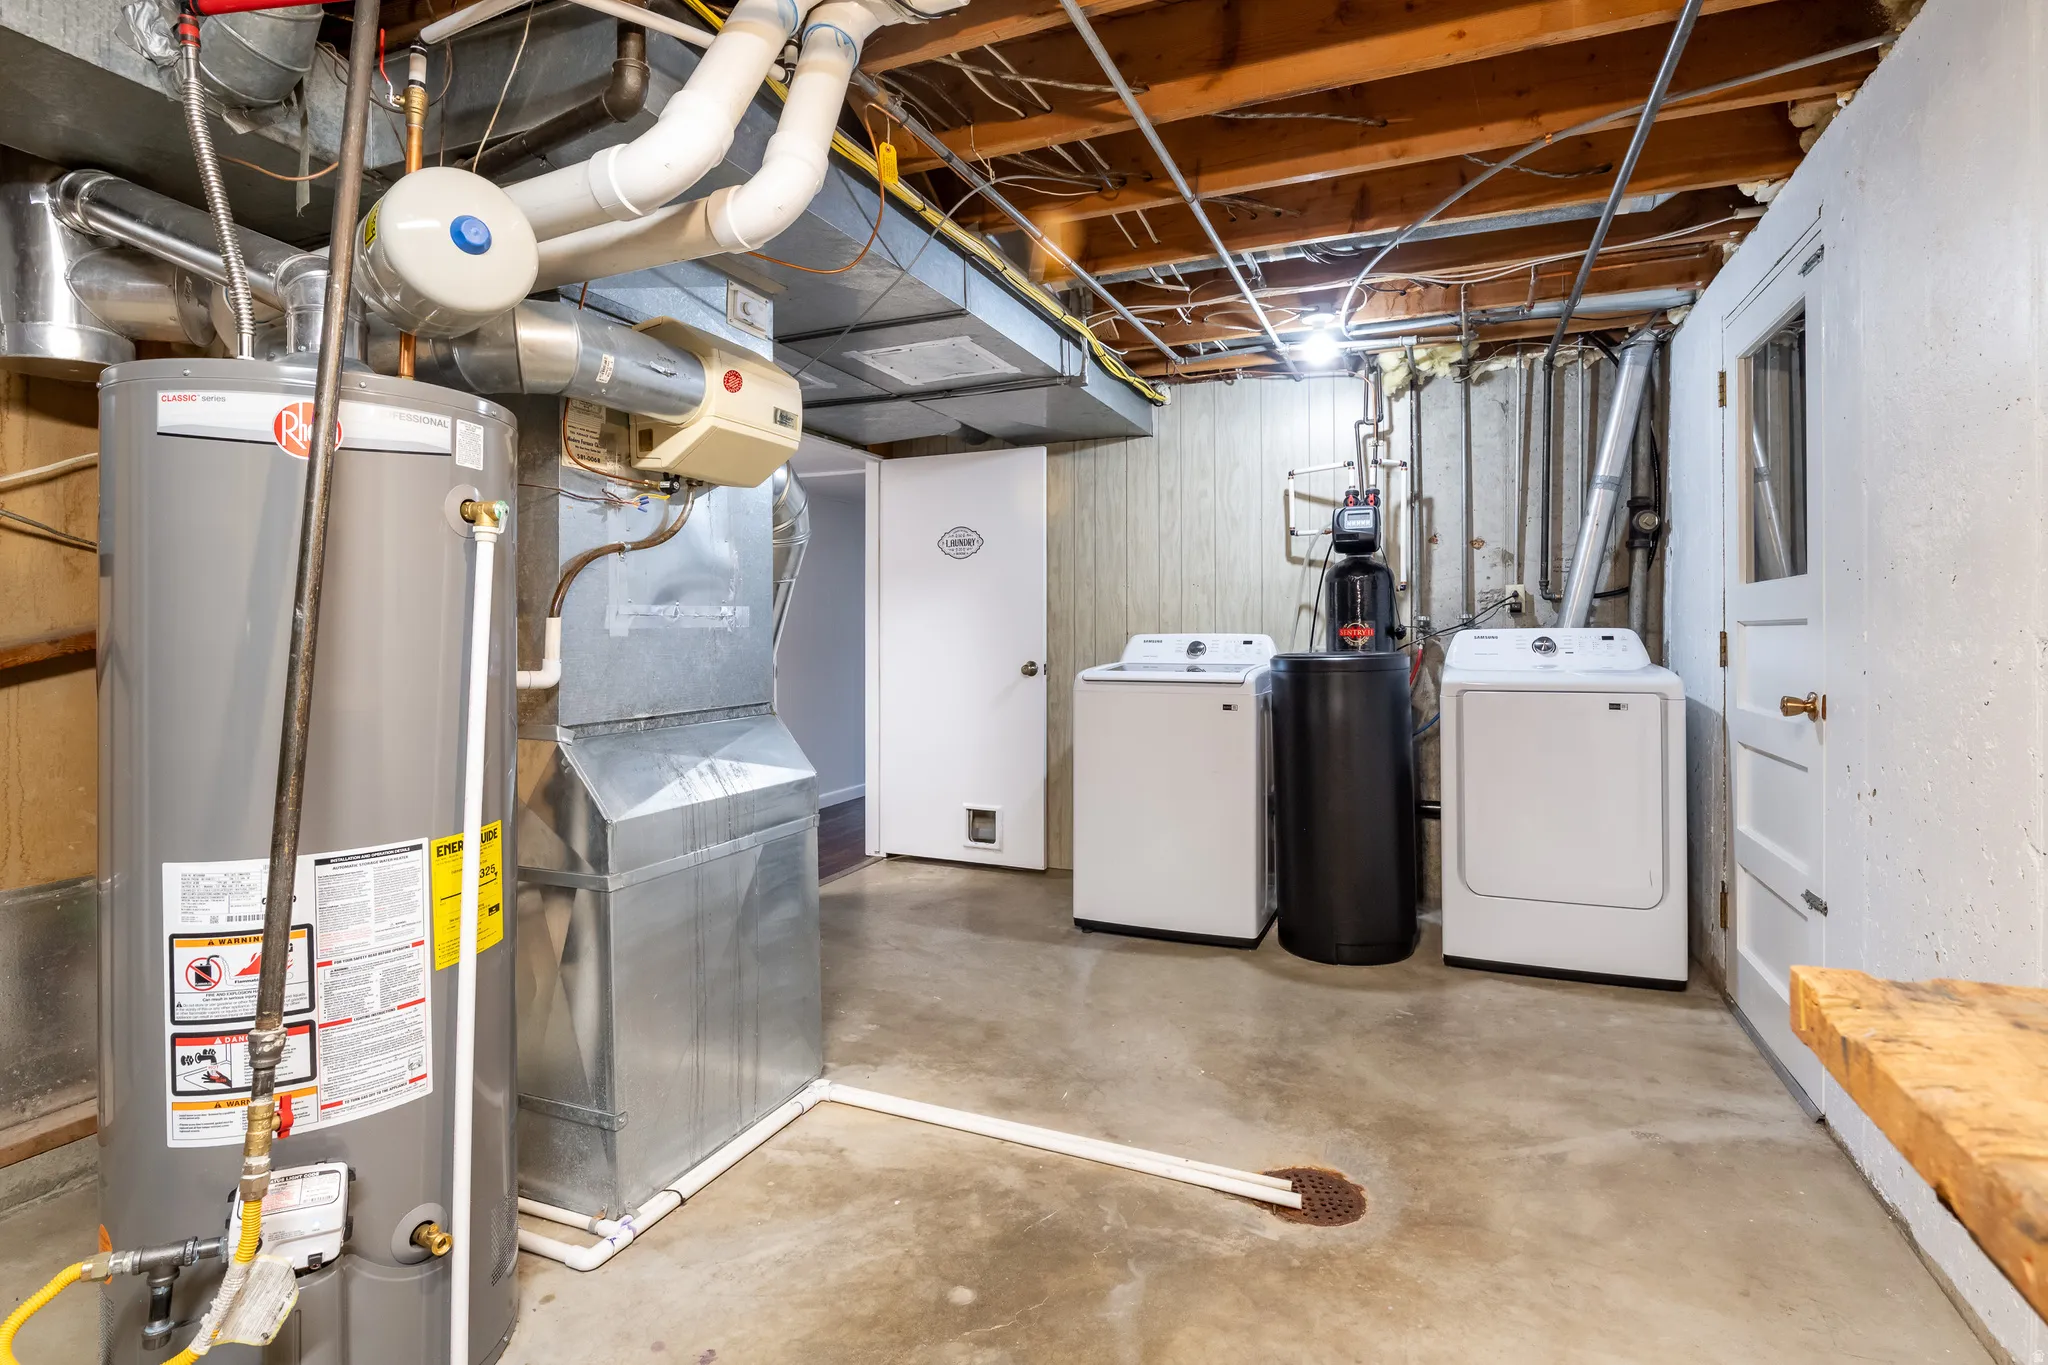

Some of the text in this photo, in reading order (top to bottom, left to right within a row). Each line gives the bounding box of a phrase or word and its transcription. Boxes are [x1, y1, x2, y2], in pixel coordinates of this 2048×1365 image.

[945, 538, 976, 547] LAUNDRY
[1339, 629, 1367, 637] SENTRY
[218, 936, 264, 945] WARNIN
[224, 1036, 249, 1044] DAN
[226, 1099, 251, 1107] WARN
